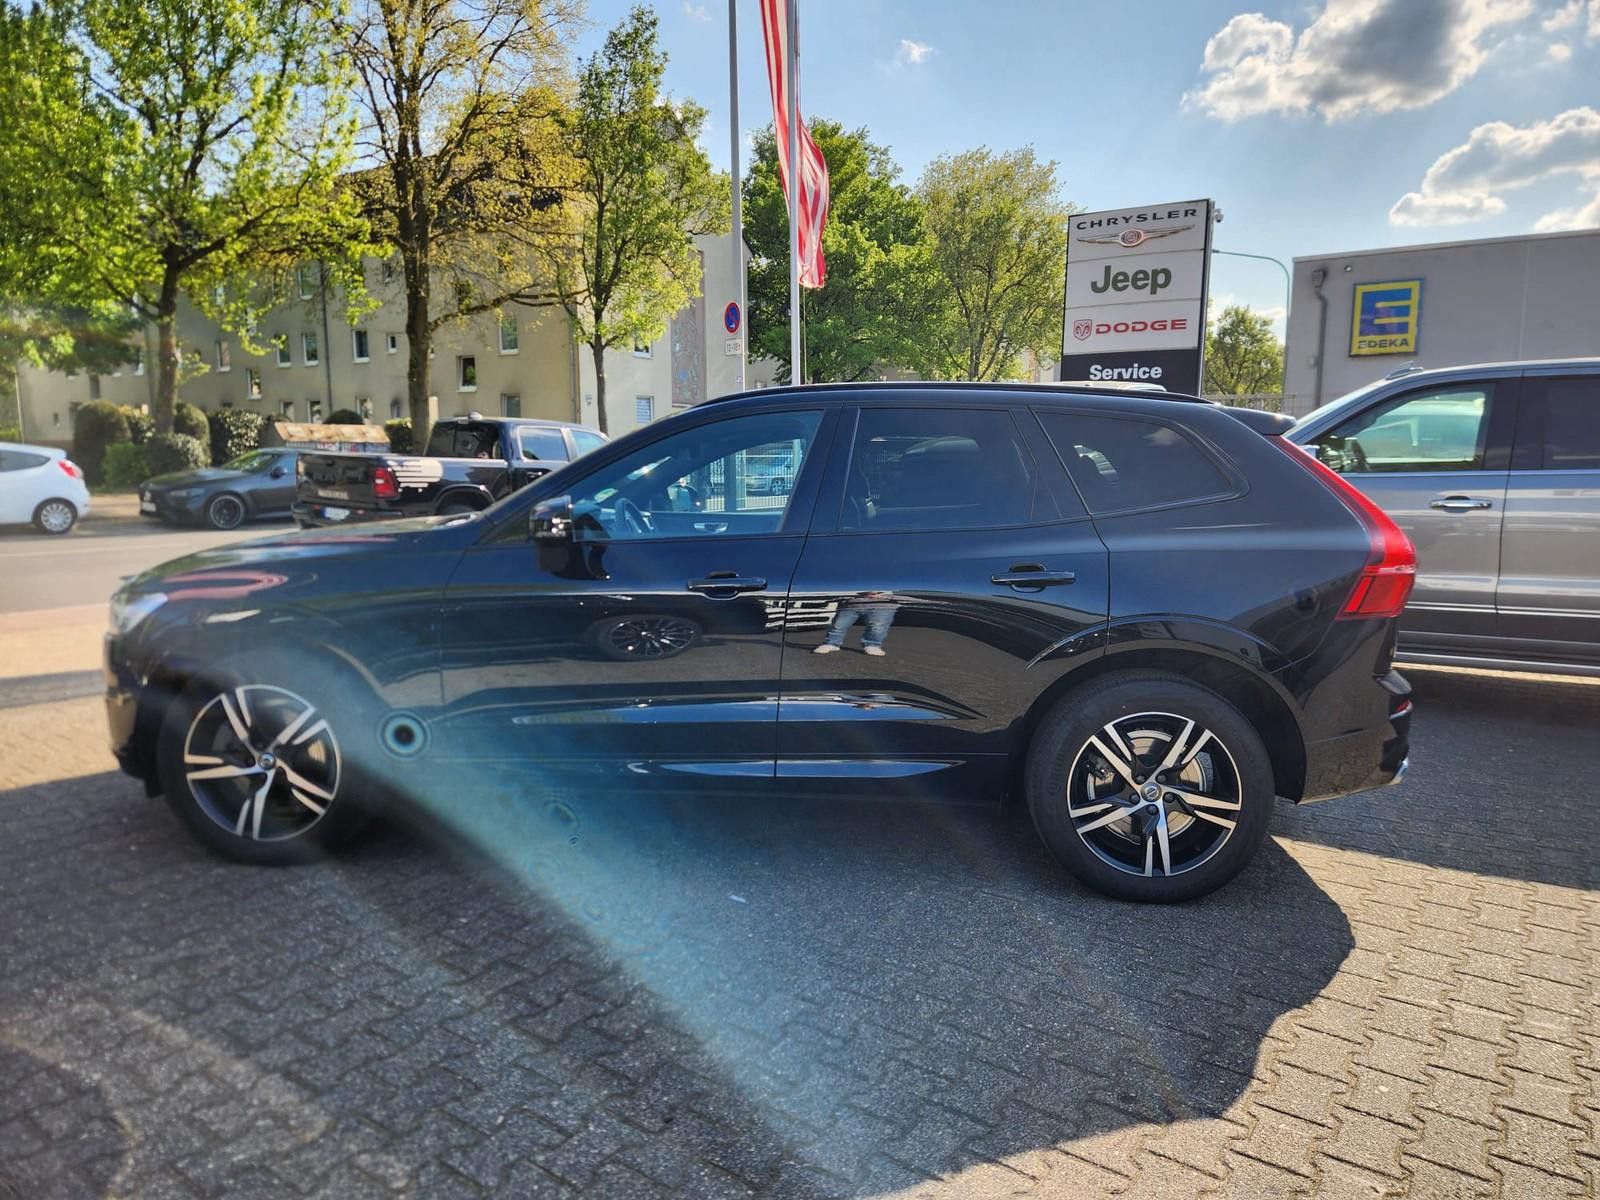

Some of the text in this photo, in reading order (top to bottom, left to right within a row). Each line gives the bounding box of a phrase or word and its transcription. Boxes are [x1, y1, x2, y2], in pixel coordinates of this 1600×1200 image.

[1076, 208, 1198, 230] CHRYSLER
[1091, 265, 1172, 295] Jeep
[1095, 318, 1188, 335] DODGE
[1357, 338, 1409, 350] EDEKA
[1089, 363, 1163, 381] Service
